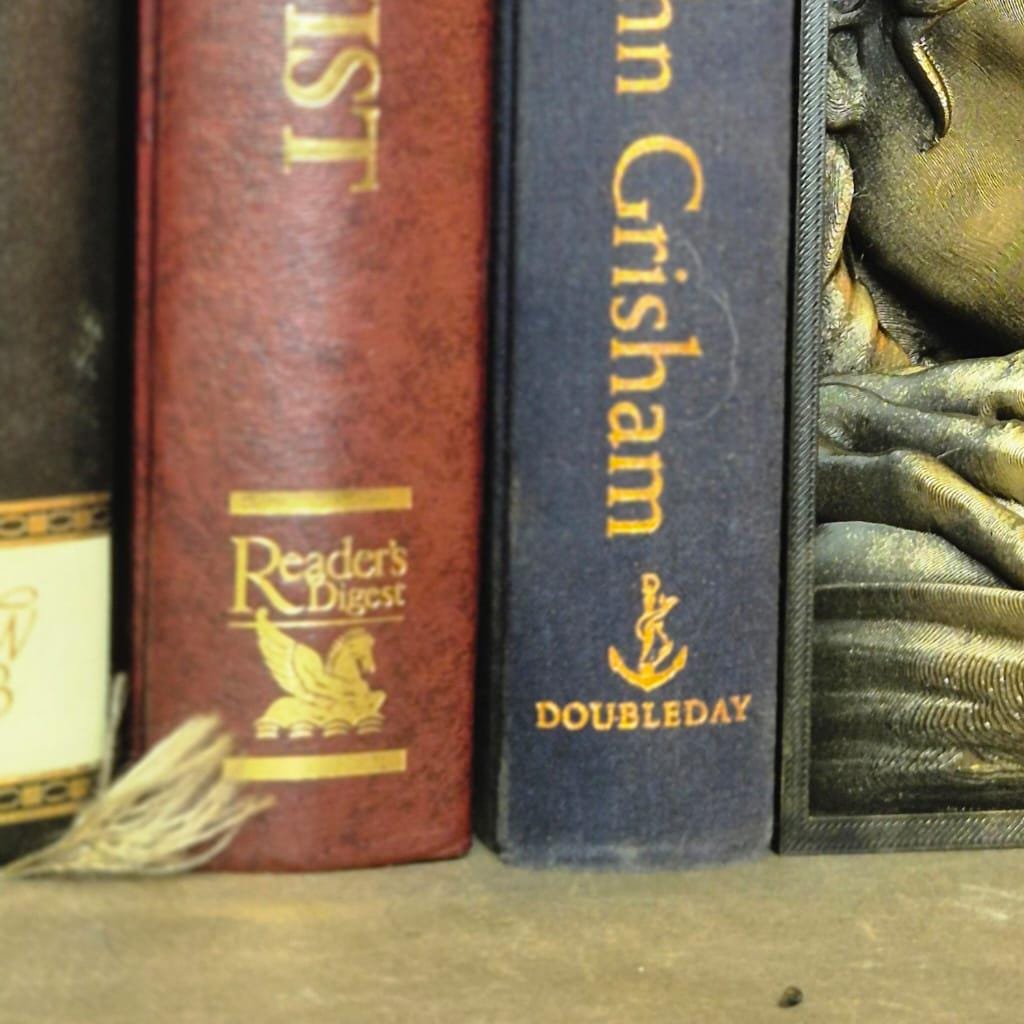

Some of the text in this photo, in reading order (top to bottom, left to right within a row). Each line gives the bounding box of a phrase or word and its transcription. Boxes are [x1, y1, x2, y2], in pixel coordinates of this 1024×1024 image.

[605, 134, 705, 540] Grisham
[228, 534, 408, 615] Reader's
[305, 579, 407, 616] Digest
[535, 693, 752, 731] DOUBLEDAY
